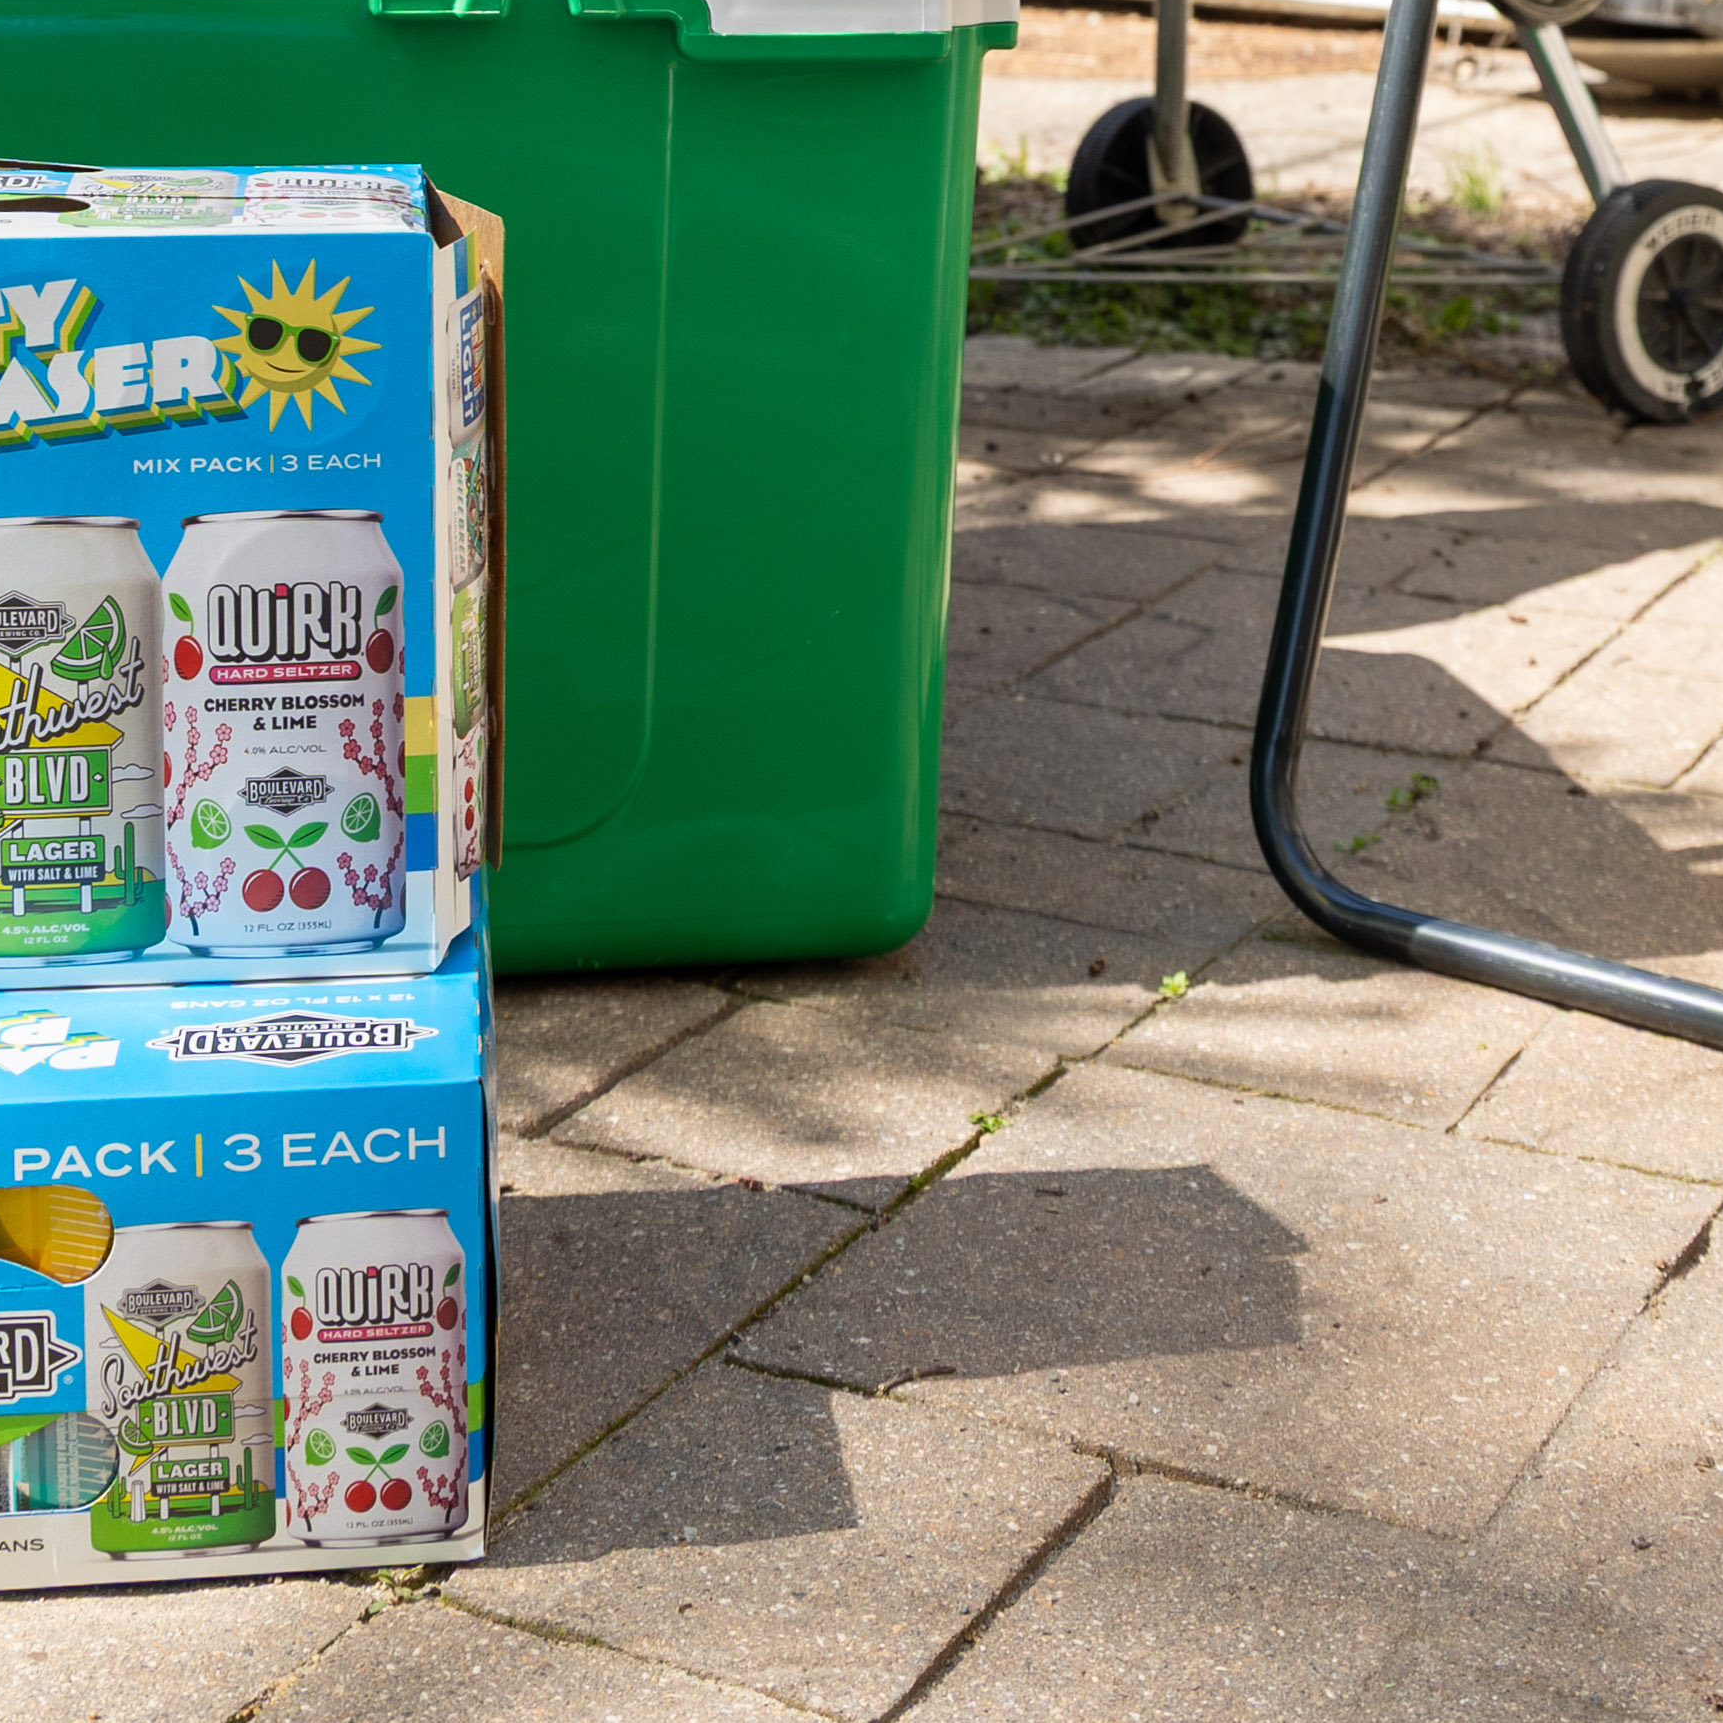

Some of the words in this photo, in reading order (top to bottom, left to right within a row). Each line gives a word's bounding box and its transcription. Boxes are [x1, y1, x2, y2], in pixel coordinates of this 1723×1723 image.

[462, 312, 474, 419] LIGHT
[134, 459, 180, 474] MIX
[191, 456, 262, 473] PACK
[281, 455, 298, 472] 3
[308, 453, 381, 471] EACH
[215, 666, 268, 680] HARD
[273, 663, 353, 678] SELTZER
[204, 695, 277, 712] CHERRY
[280, 693, 365, 711] BLOSSOM
[252, 716, 267, 732] &
[272, 714, 317, 730] LIME
[243, 746, 267, 756] 4.0%
[268, 744, 326, 755] ALC/VOL
[3, 755, 91, 806] BLVD
[247, 777, 323, 803] BOULEVARD
[8, 839, 98, 864] LAGER
[8, 867, 34, 882] WITH
[36, 866, 61, 881] SALT
[63, 866, 72, 880] &
[74, 864, 99, 879] LIME
[1, 925, 30, 936] 4.5%
[32, 923, 90, 935] ALC/VOL
[243, 923, 254, 933] 12
[257, 922, 273, 932] FL
[276, 922, 295, 931] OZ
[267, 1021, 356, 1031] BREWING
[188, 1024, 395, 1054] BOULEVARD
[13, 1140, 178, 1182] PACK
[223, 1133, 263, 1173] 3
[281, 1126, 447, 1168] EACH
[127, 1290, 194, 1310] BOULEVARD
[323, 1329, 361, 1341] HARD
[366, 1325, 429, 1338] SELTZER
[100, 1309, 258, 1419] Southwest
[314, 1350, 370, 1364] CHERRY
[373, 1346, 436, 1361] BLOSSOM
[351, 1365, 361, 1377] &
[365, 1364, 400, 1376] LIME
[152, 1399, 218, 1438] BLVD
[348, 1412, 407, 1431] BOULEVARD
[156, 1462, 224, 1480] LAGER
[156, 1482, 176, 1495] WITH
[177, 1481, 196, 1493] SALT
[197, 1481, 205, 1492] &
[206, 1480, 226, 1492] LIME
